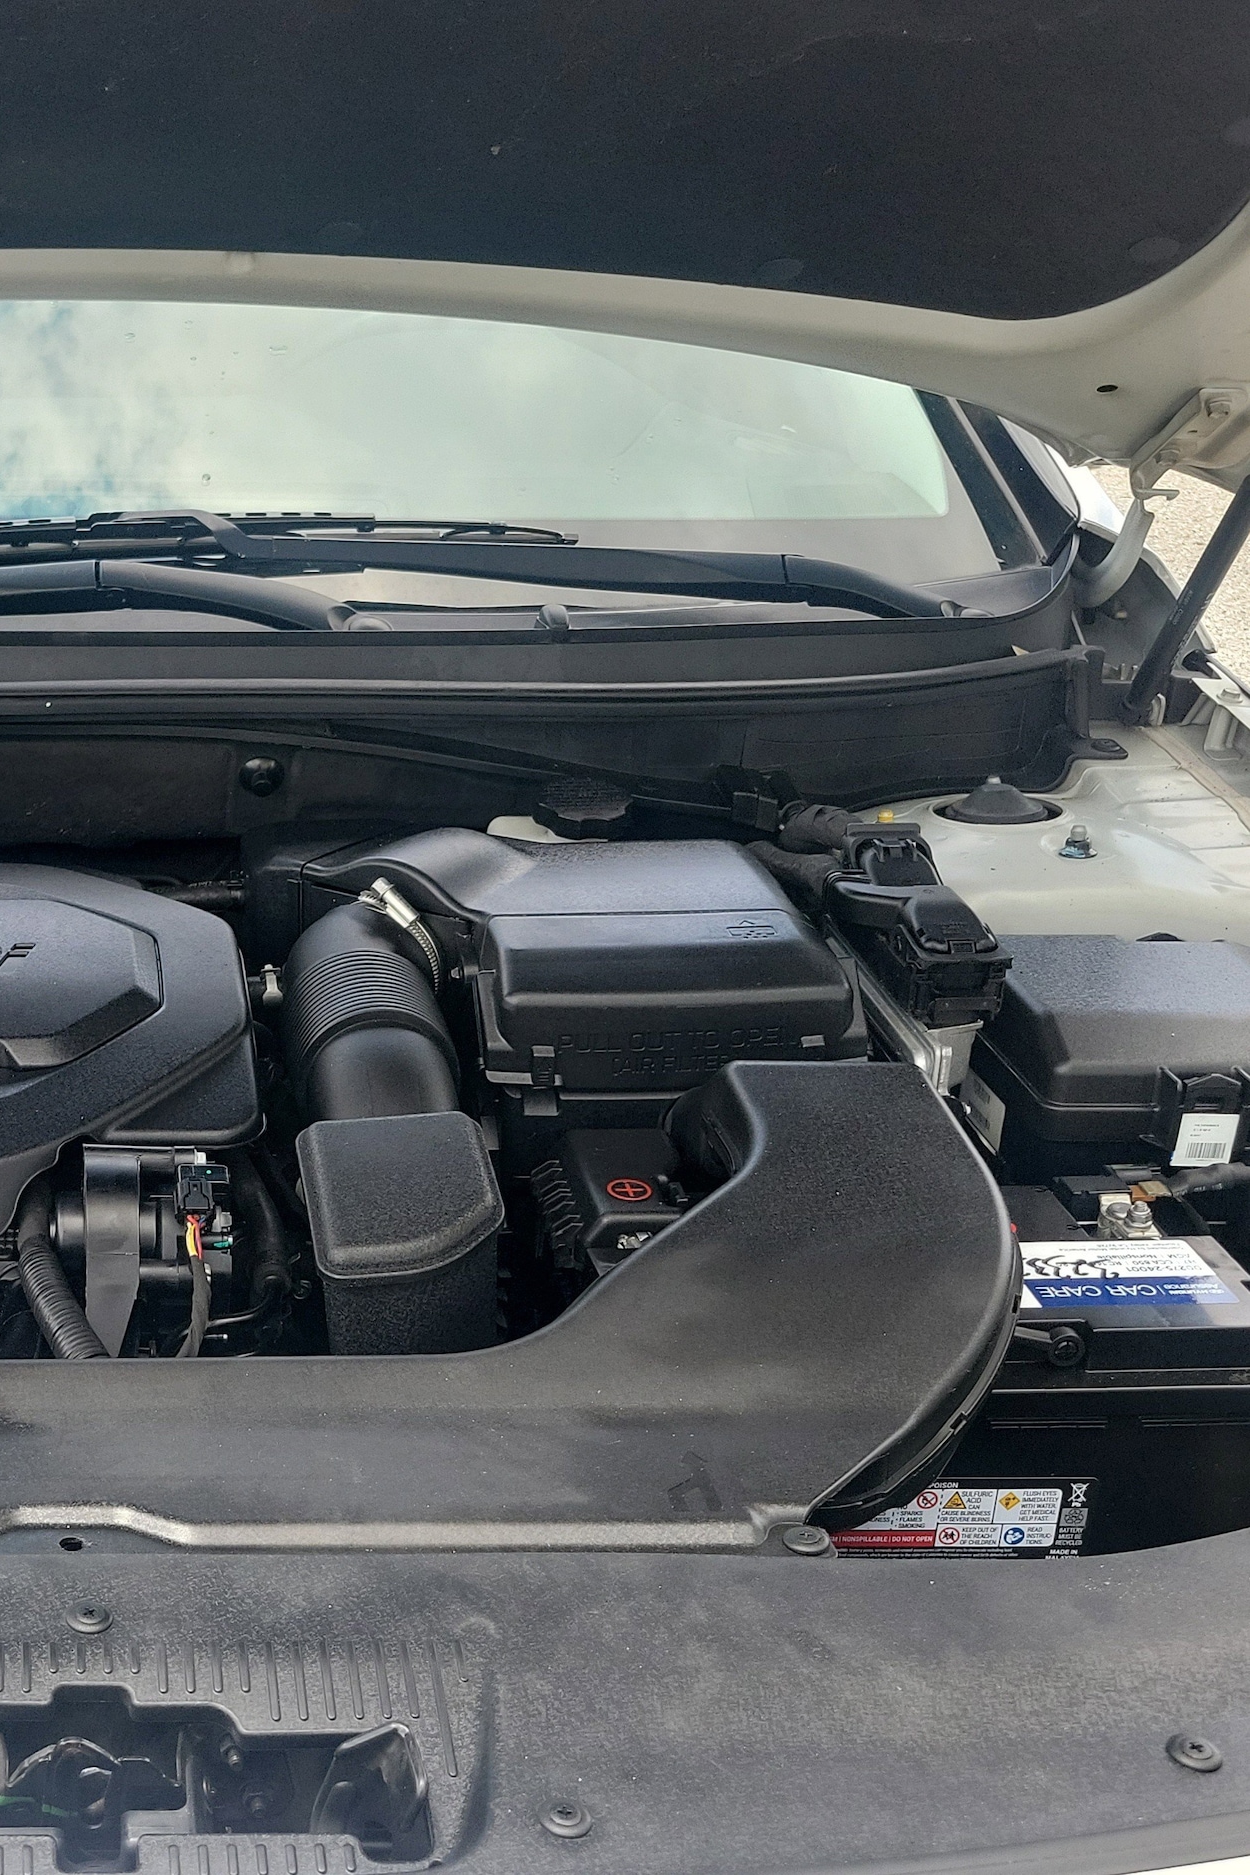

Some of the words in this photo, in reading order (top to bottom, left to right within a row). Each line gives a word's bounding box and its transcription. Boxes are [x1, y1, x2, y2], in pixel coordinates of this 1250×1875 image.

[558, 1034, 622, 1054] PULL
[632, 1032, 681, 1051] OUT
[688, 1031, 720, 1049] TO
[1035, 1285, 1102, 1298] CARE
[1104, 1284, 1157, 1297] CAR
